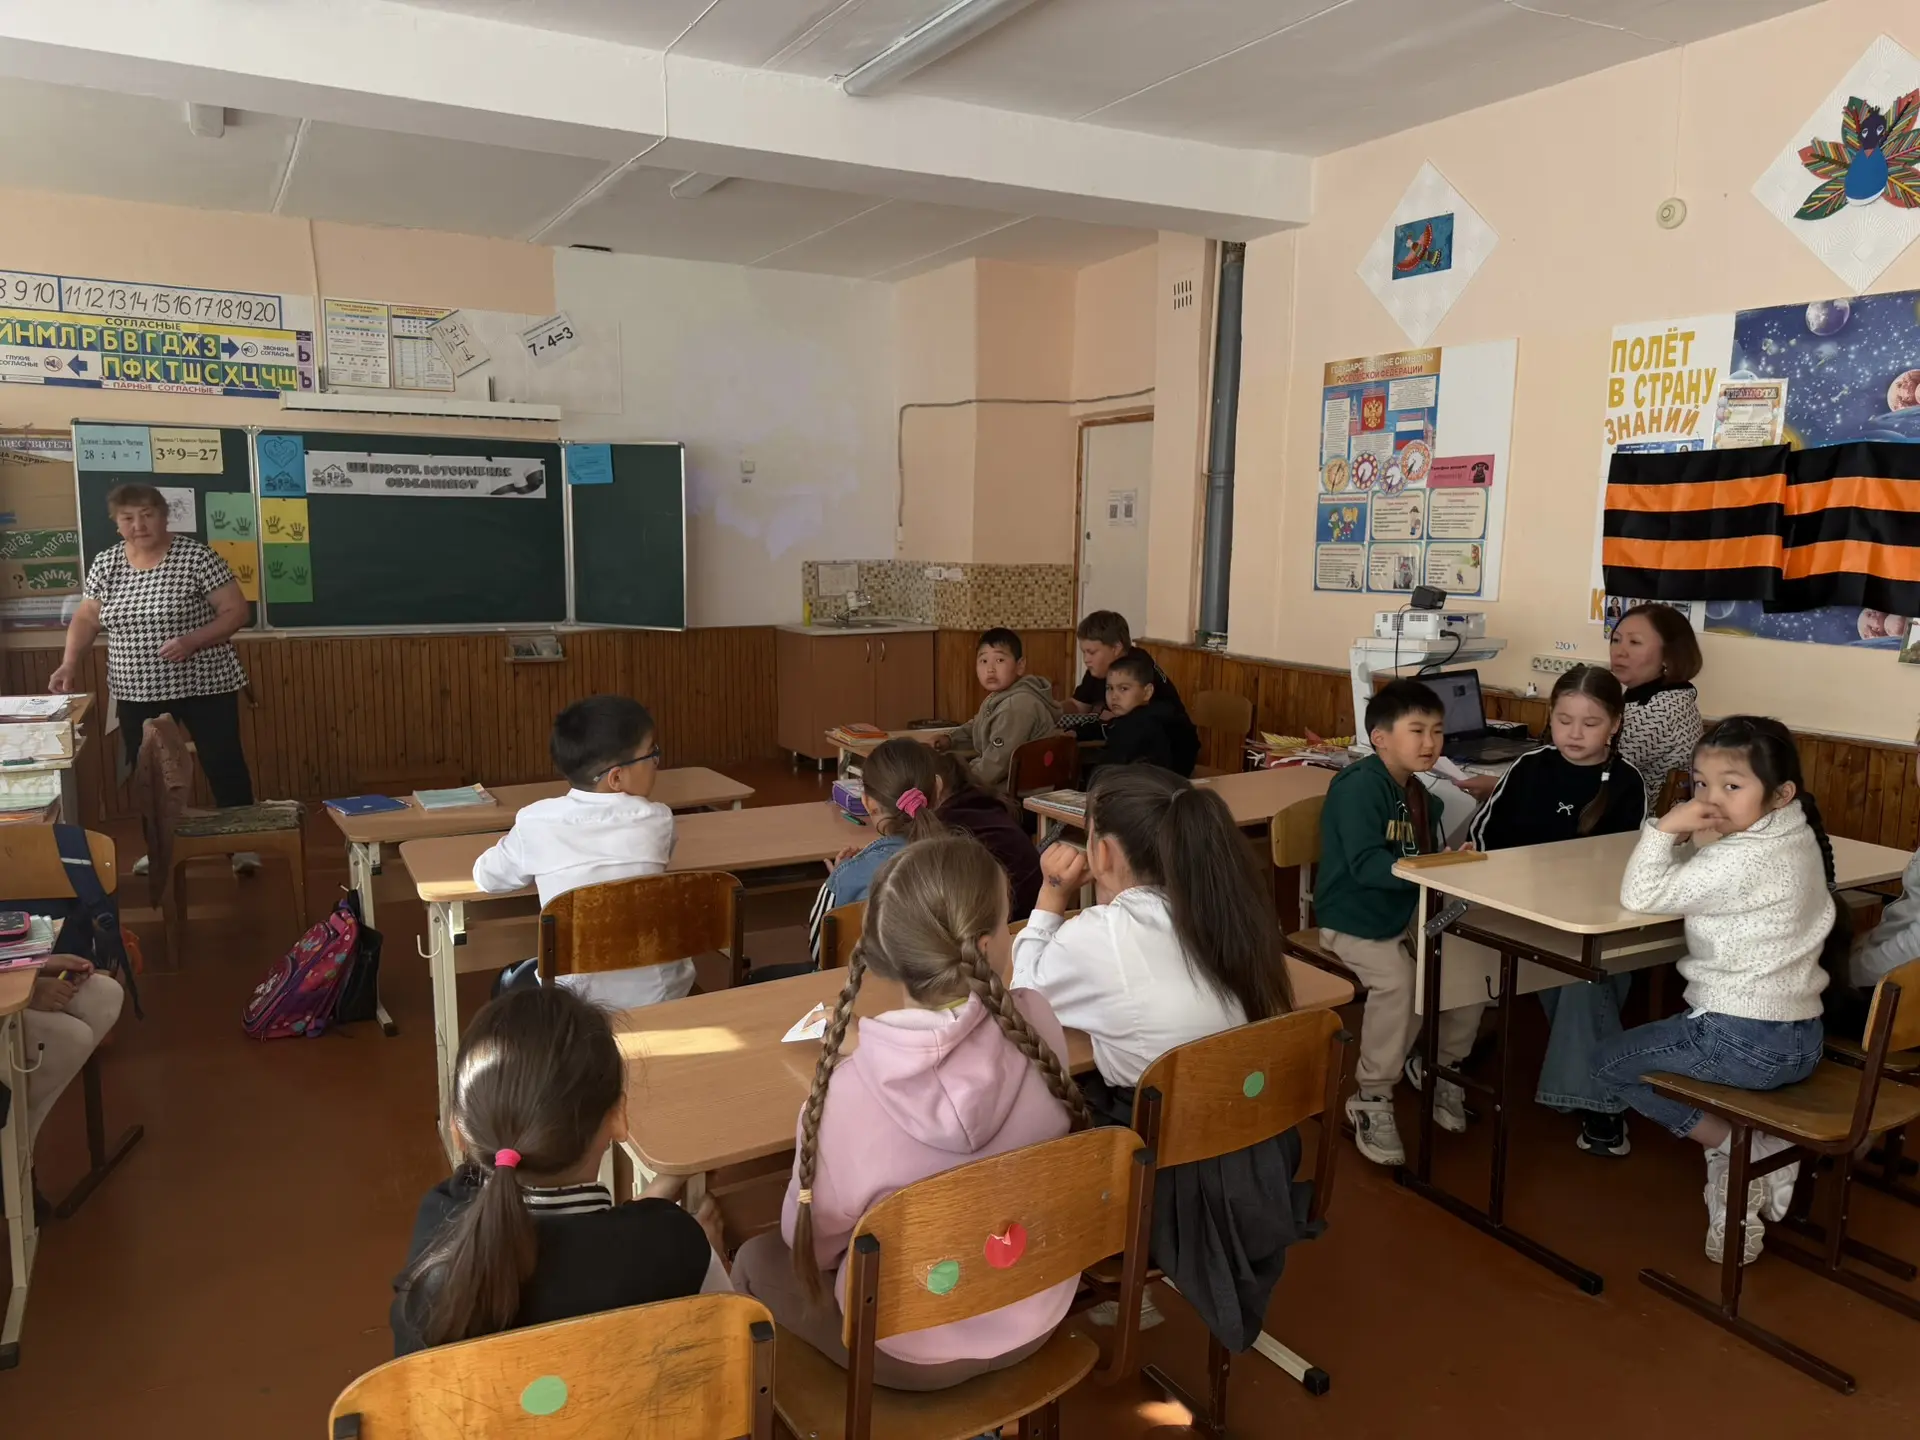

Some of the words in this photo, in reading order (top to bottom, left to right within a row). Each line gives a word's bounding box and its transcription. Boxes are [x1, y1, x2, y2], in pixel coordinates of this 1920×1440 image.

[14, 280, 27, 301] 9
[33, 283, 54, 303] 10
[65, 286, 81, 306] 11
[84, 288, 104, 308] 12
[107, 289, 126, 310] 13
[130, 292, 148, 311] 14
[152, 293, 170, 313] 15
[173, 295, 191, 315] 16
[195, 297, 213, 316] 17
[215, 299, 233, 318] 18
[235, 300, 252, 320] 19
[254, 302, 276, 322] 20
[105, 318, 181, 331] СОГЛАСНЫЕ
[1610, 327, 1695, 373] ПОЛЁТ
[1380, 365, 1423, 378] ФЕДЕРАЦИИ
[113, 381, 152, 390] ПАРНЫЕ
[157, 382, 214, 394] СОГЛАСНЫЕ
[1607, 377, 1625, 409] В
[1633, 367, 1717, 409] СТРАНУ
[1604, 404, 1700, 446] ЗНАНИЙ
[84, 450, 94, 460] 28
